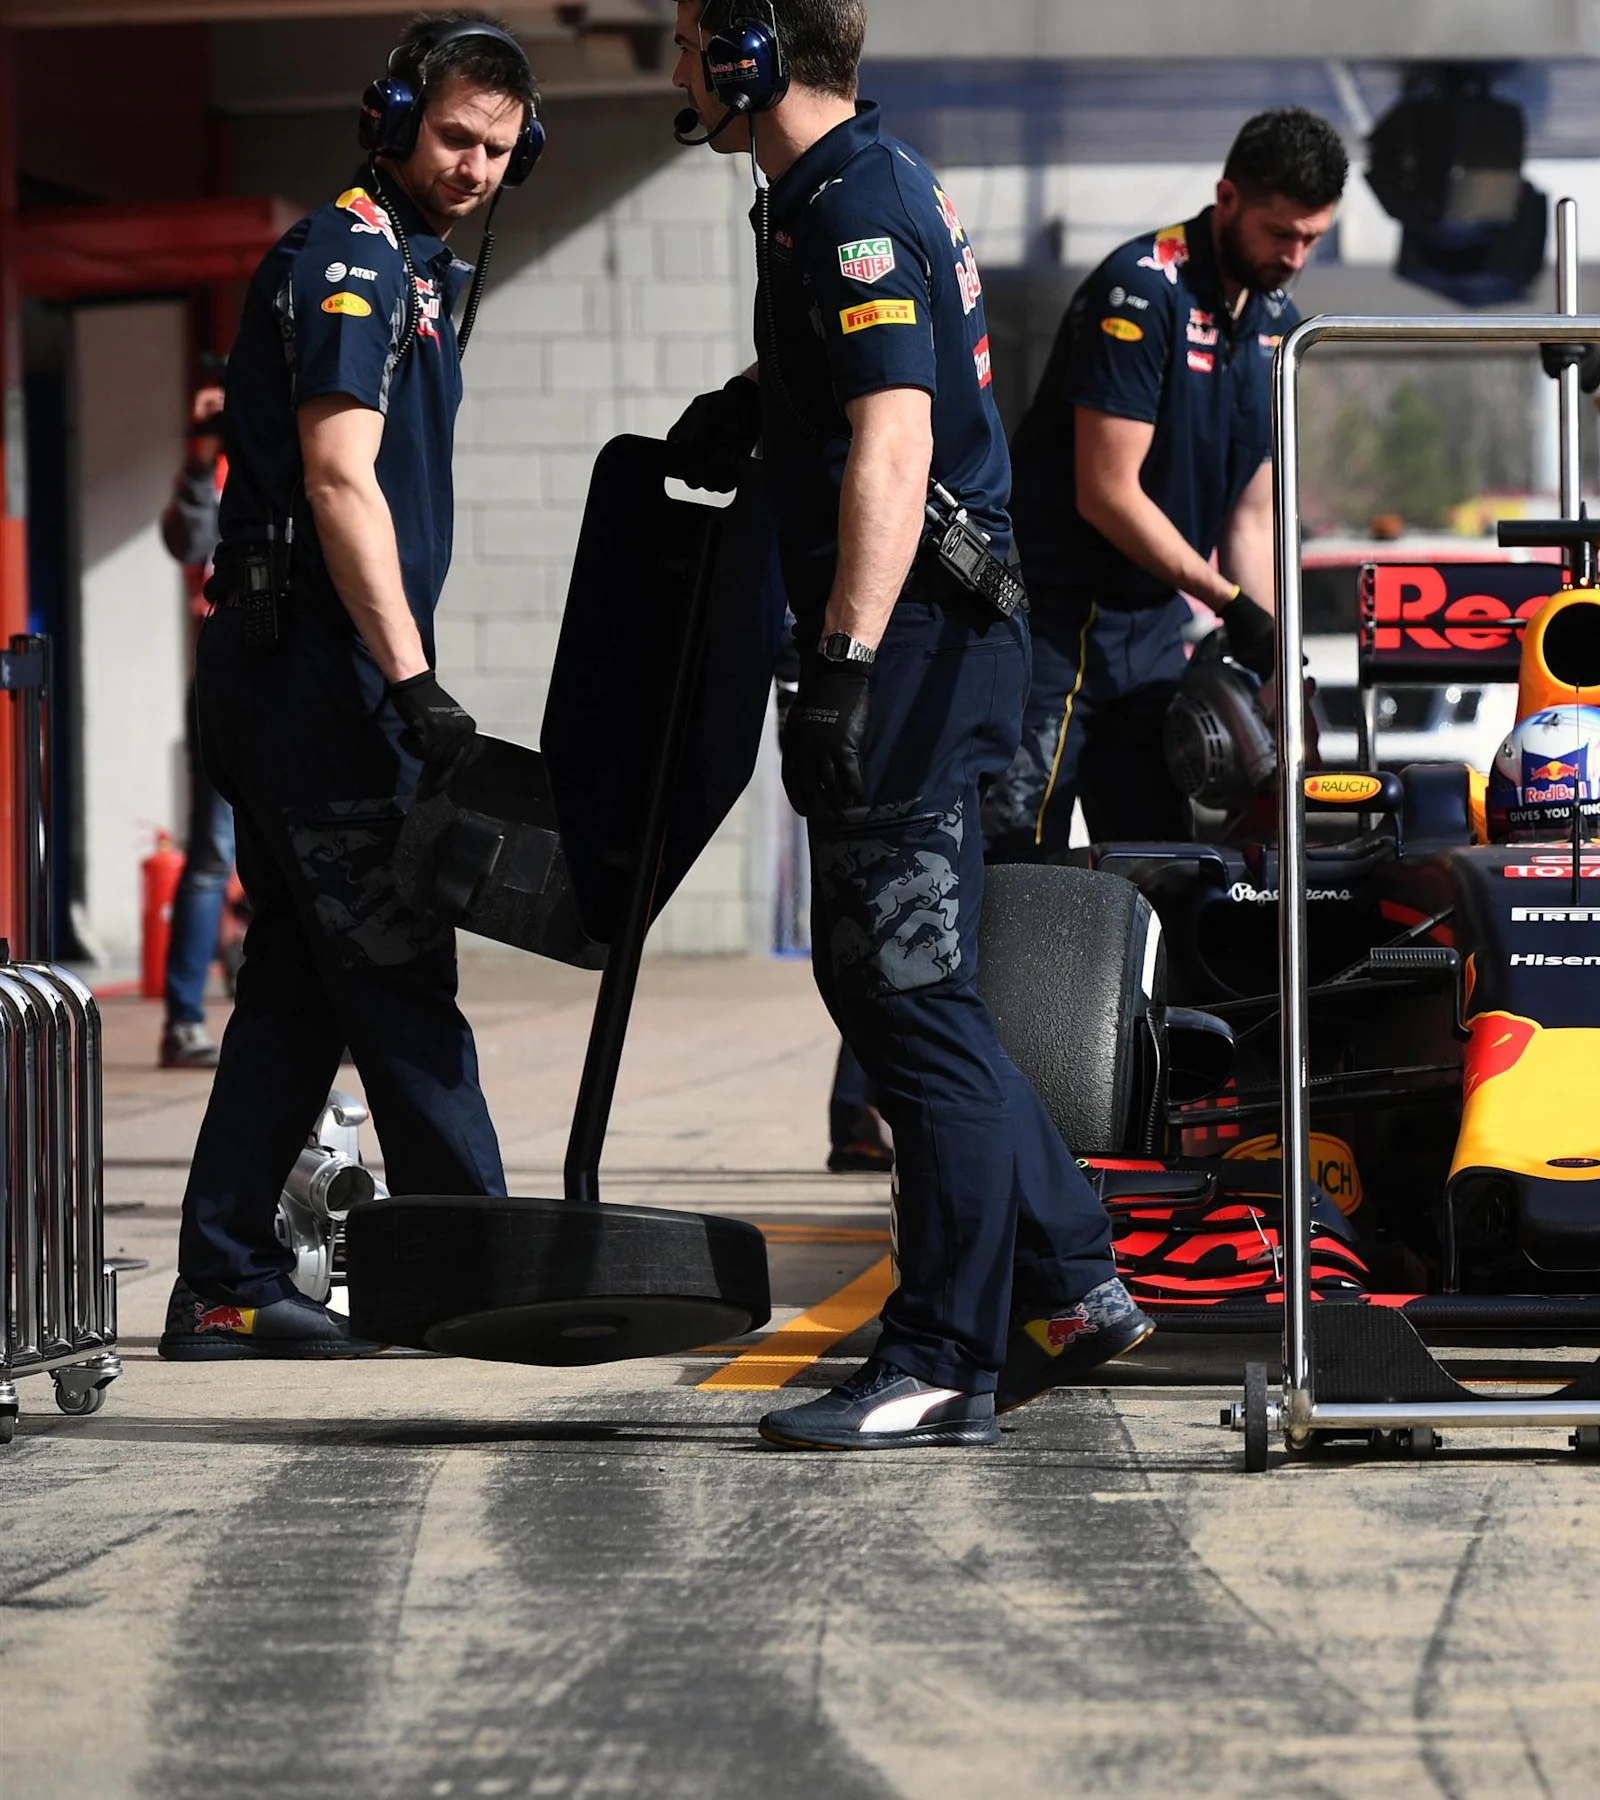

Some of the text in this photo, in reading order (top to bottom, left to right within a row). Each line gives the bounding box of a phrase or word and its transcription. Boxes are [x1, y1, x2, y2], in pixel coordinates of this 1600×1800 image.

[842, 241, 888, 259] TAG
[349, 266, 378, 281] AT&T
[844, 257, 892, 279] HEUER
[847, 305, 908, 328] PIRELLI
[1320, 780, 1370, 793] RAUCH
[1526, 784, 1555, 803] Red
[1510, 809, 1541, 822] GIVES
[1544, 807, 1570, 819] YOU
